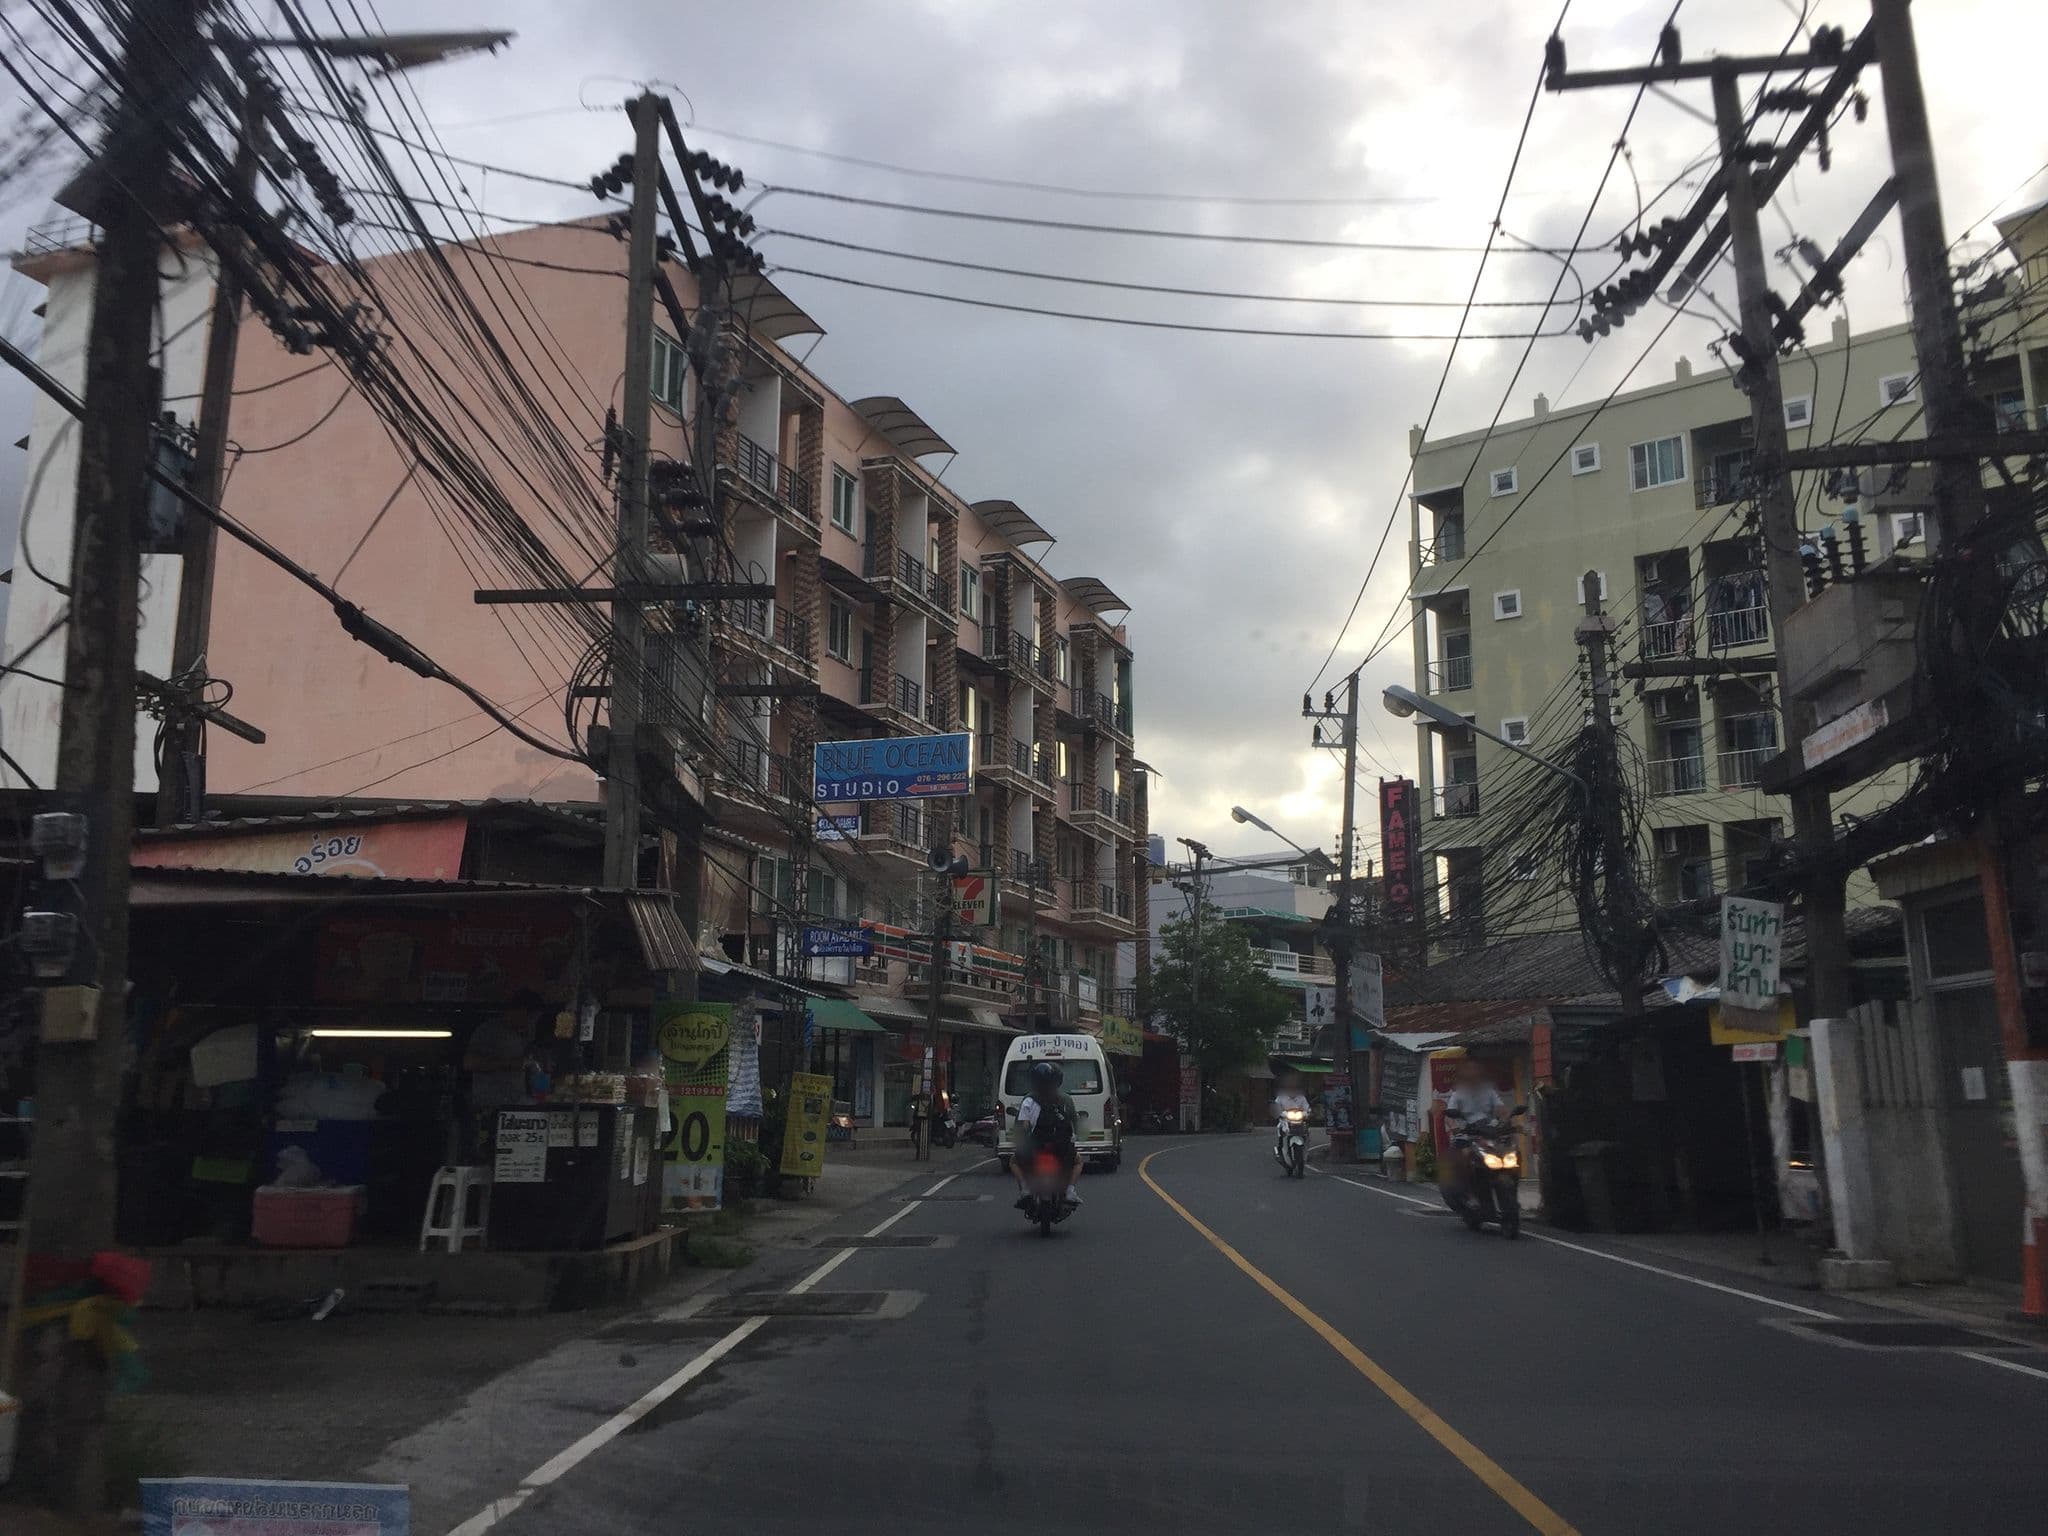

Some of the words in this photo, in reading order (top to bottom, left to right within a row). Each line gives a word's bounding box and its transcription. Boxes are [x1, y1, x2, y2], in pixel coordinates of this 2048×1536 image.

[821, 744, 875, 772] BLUE
[885, 740, 964, 769] OCEAN
[294, 832, 361, 873] อร่อย
